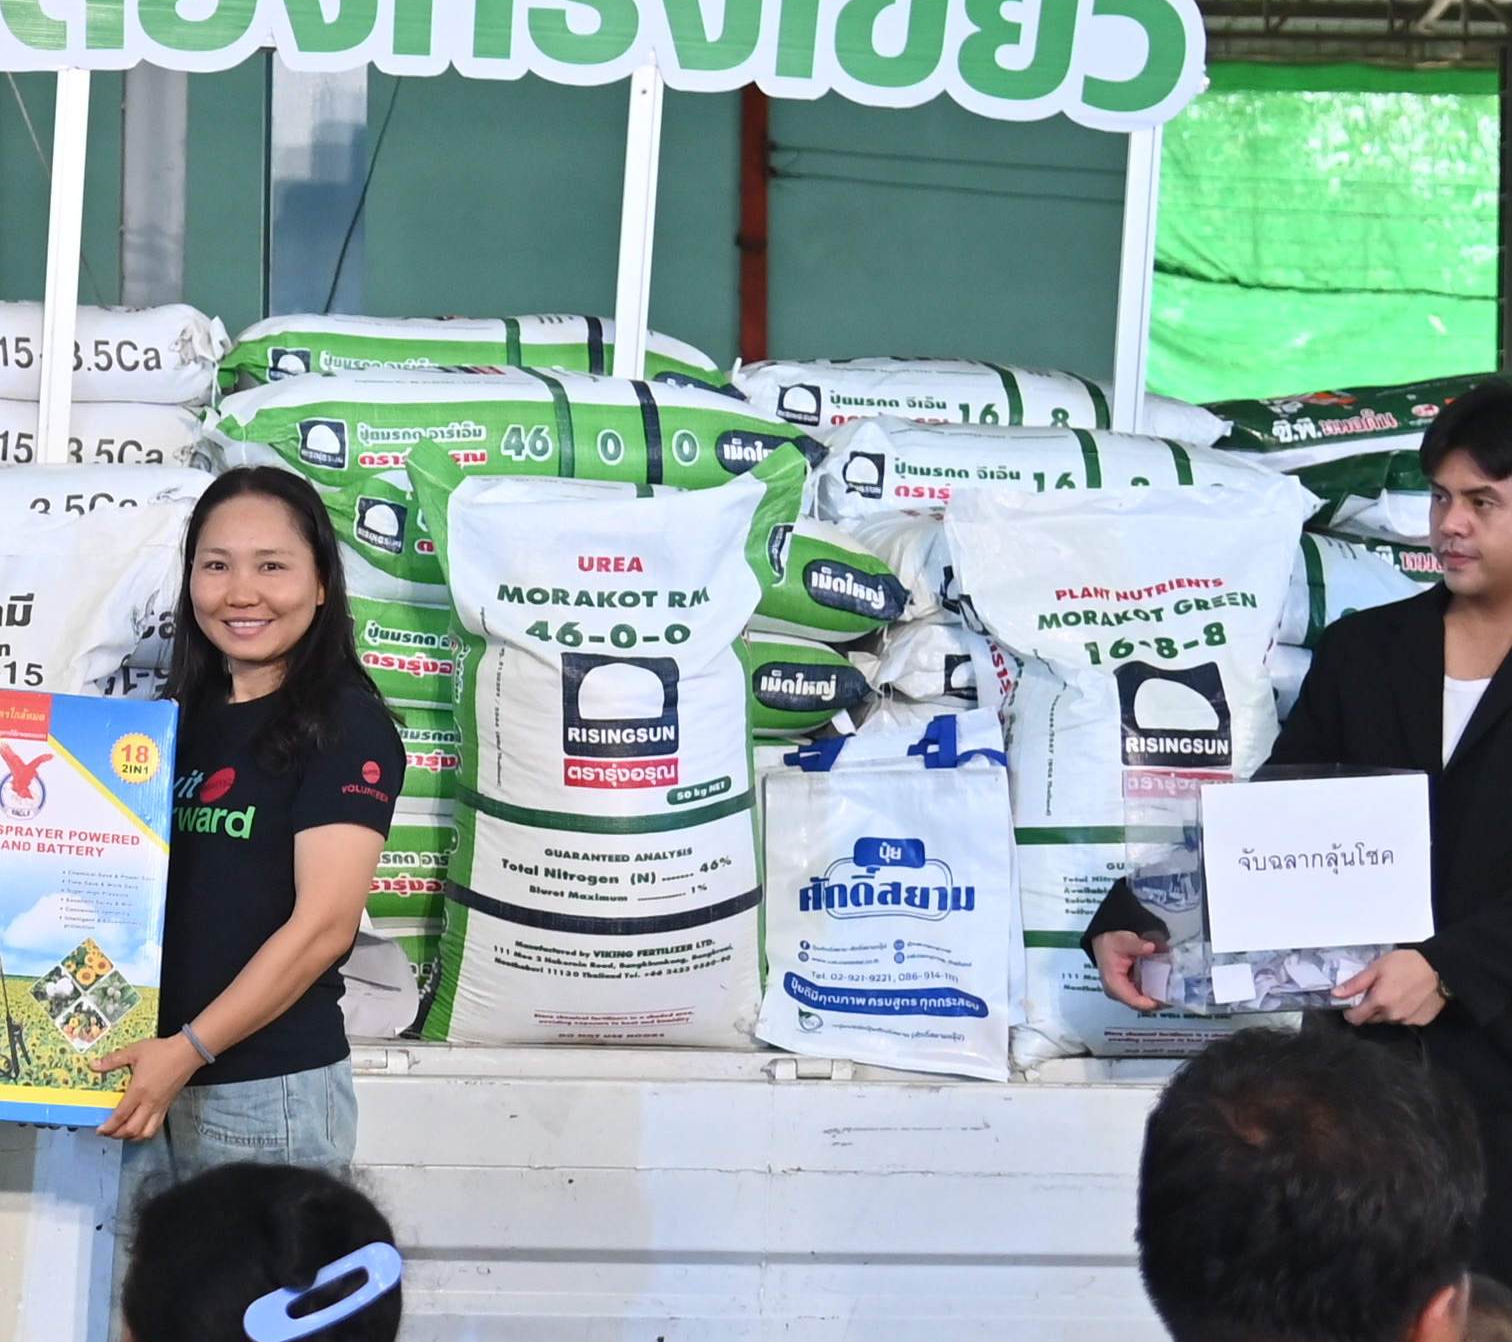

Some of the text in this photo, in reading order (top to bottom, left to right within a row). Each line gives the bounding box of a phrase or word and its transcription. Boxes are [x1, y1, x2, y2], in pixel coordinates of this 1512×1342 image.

[830, 390, 899, 409] ปุ๋ยมรกต
[958, 402, 999, 425] 16
[358, 424, 422, 443] ปุ๋ยมรกต
[501, 426, 551, 460] 46
[598, 429, 623, 465] 0
[673, 430, 699, 465] 0
[895, 457, 969, 479] ปุ๋ยมรกต
[578, 556, 644, 573] UREA
[497, 584, 710, 608] MORAKOT RM
[812, 566, 885, 609] เม็ดใหญ่
[1055, 578, 1224, 602] PLANT NUTRIENTS
[1038, 592, 1258, 631] MORAKOT GREEN
[365, 623, 437, 648] ปุ๋ยมรกต
[526, 620, 691, 649] 46-0-0
[1084, 622, 1226, 666] 16-8-8
[760, 670, 837, 700] เม็ดใหญ่
[568, 726, 675, 744] RISINGSUN
[1126, 737, 1228, 755] RISINGSUN
[121, 744, 149, 764] 18
[122, 764, 149, 775] 2IN1
[567, 763, 675, 786] ตรารุ่งอรุณ
[677, 781, 726, 801] 50 kg NET
[175, 806, 256, 839] ward
[1, 839, 31, 851] AND
[36, 842, 105, 858] BATTERY
[68, 830, 140, 846] POWERED
[544, 847, 693, 863] GUARANTEED ANALYSIS
[879, 842, 901, 863] ปุ๋ย
[1239, 842, 1394, 875] จับฉลากลุ้นโชค
[501, 855, 732, 885] Total Nitrogen (N) 46%
[568, 891, 628, 902] Maximum
[515, 940, 576, 957] Manufactured
[593, 950, 633, 959] VIKING
[696, 938, 715, 950] LTD.
